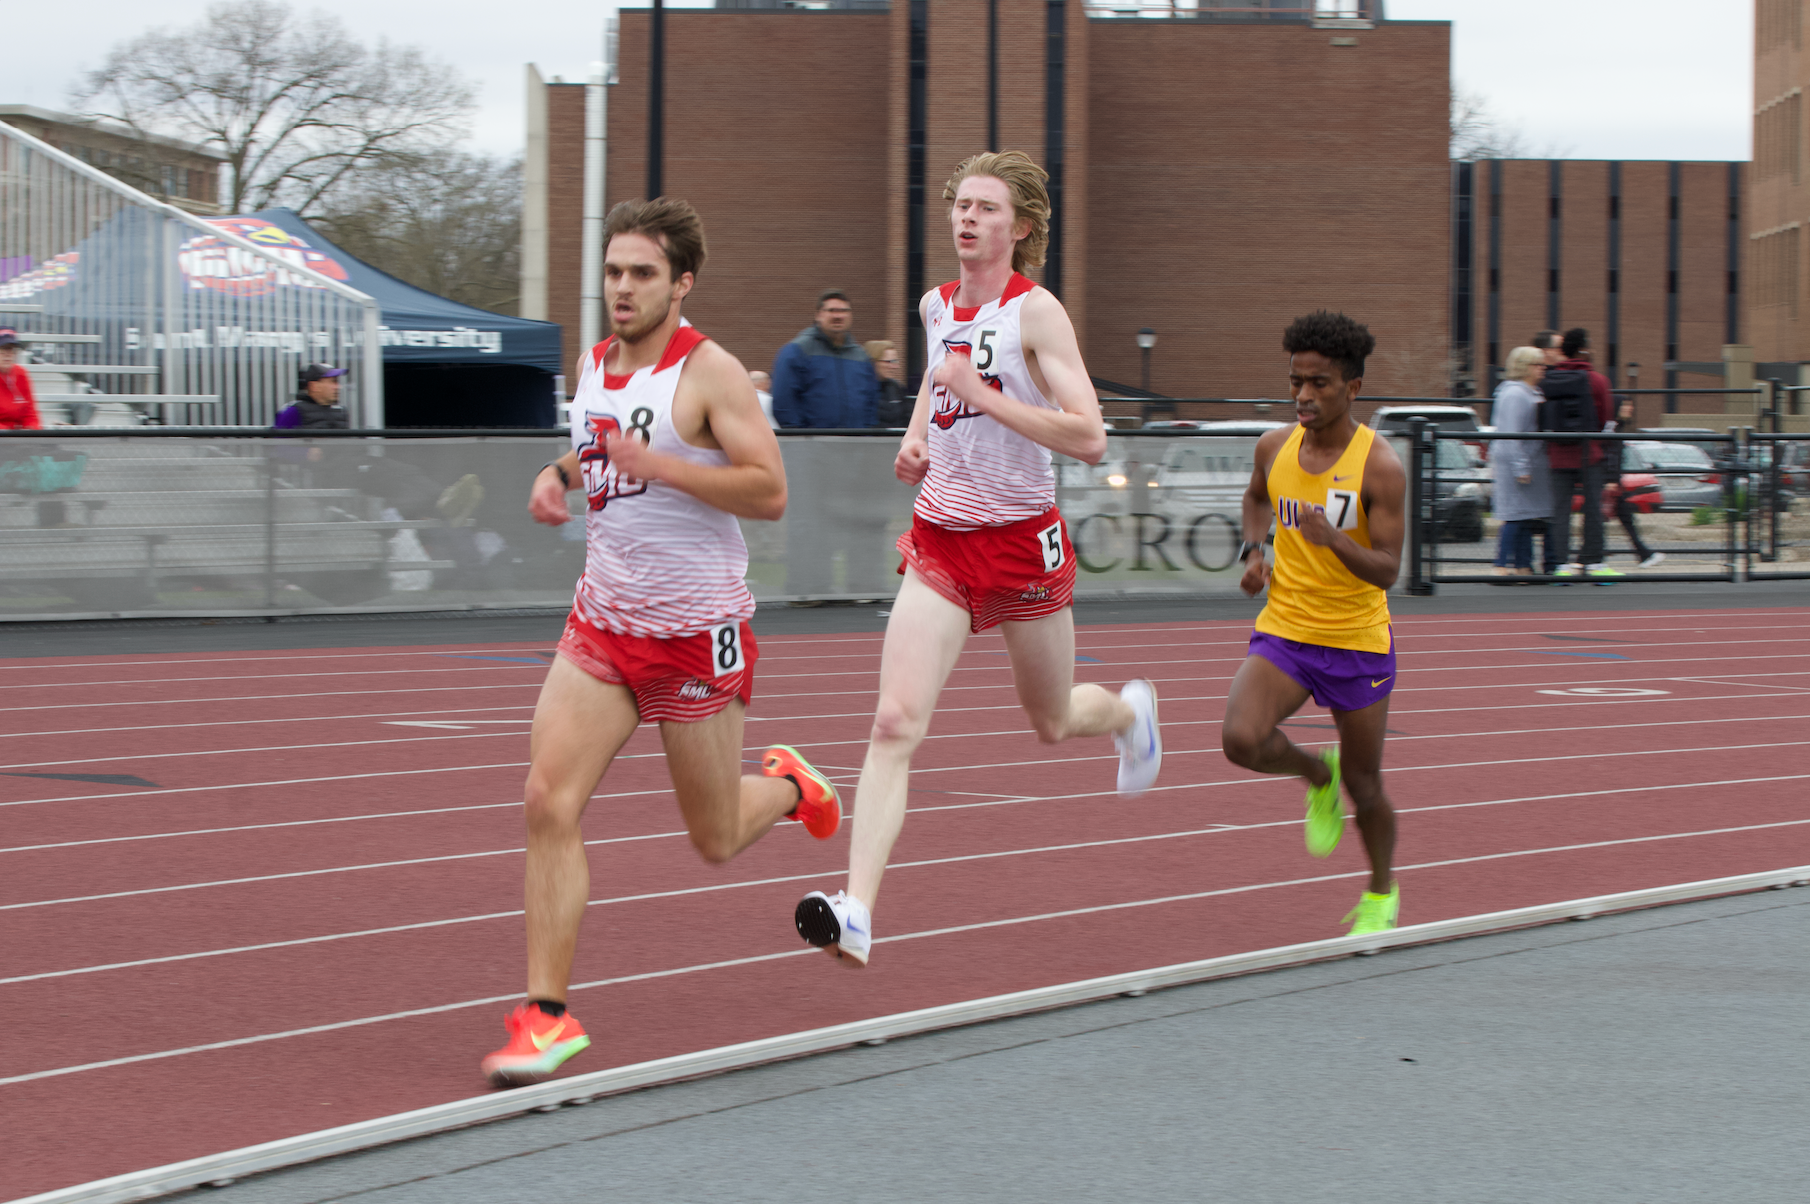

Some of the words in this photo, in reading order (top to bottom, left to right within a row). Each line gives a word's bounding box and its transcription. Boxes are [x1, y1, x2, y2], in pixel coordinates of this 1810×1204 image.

[125, 328, 213, 349] Sant
[216, 326, 331, 353] Marys
[341, 325, 502, 353] Uiversity
[977, 330, 996, 370] 5
[625, 407, 654, 450] 8
[1334, 493, 1351, 529] 7
[1046, 526, 1061, 568] 5
[1073, 513, 1275, 574] CRO
[718, 627, 737, 669] 8
